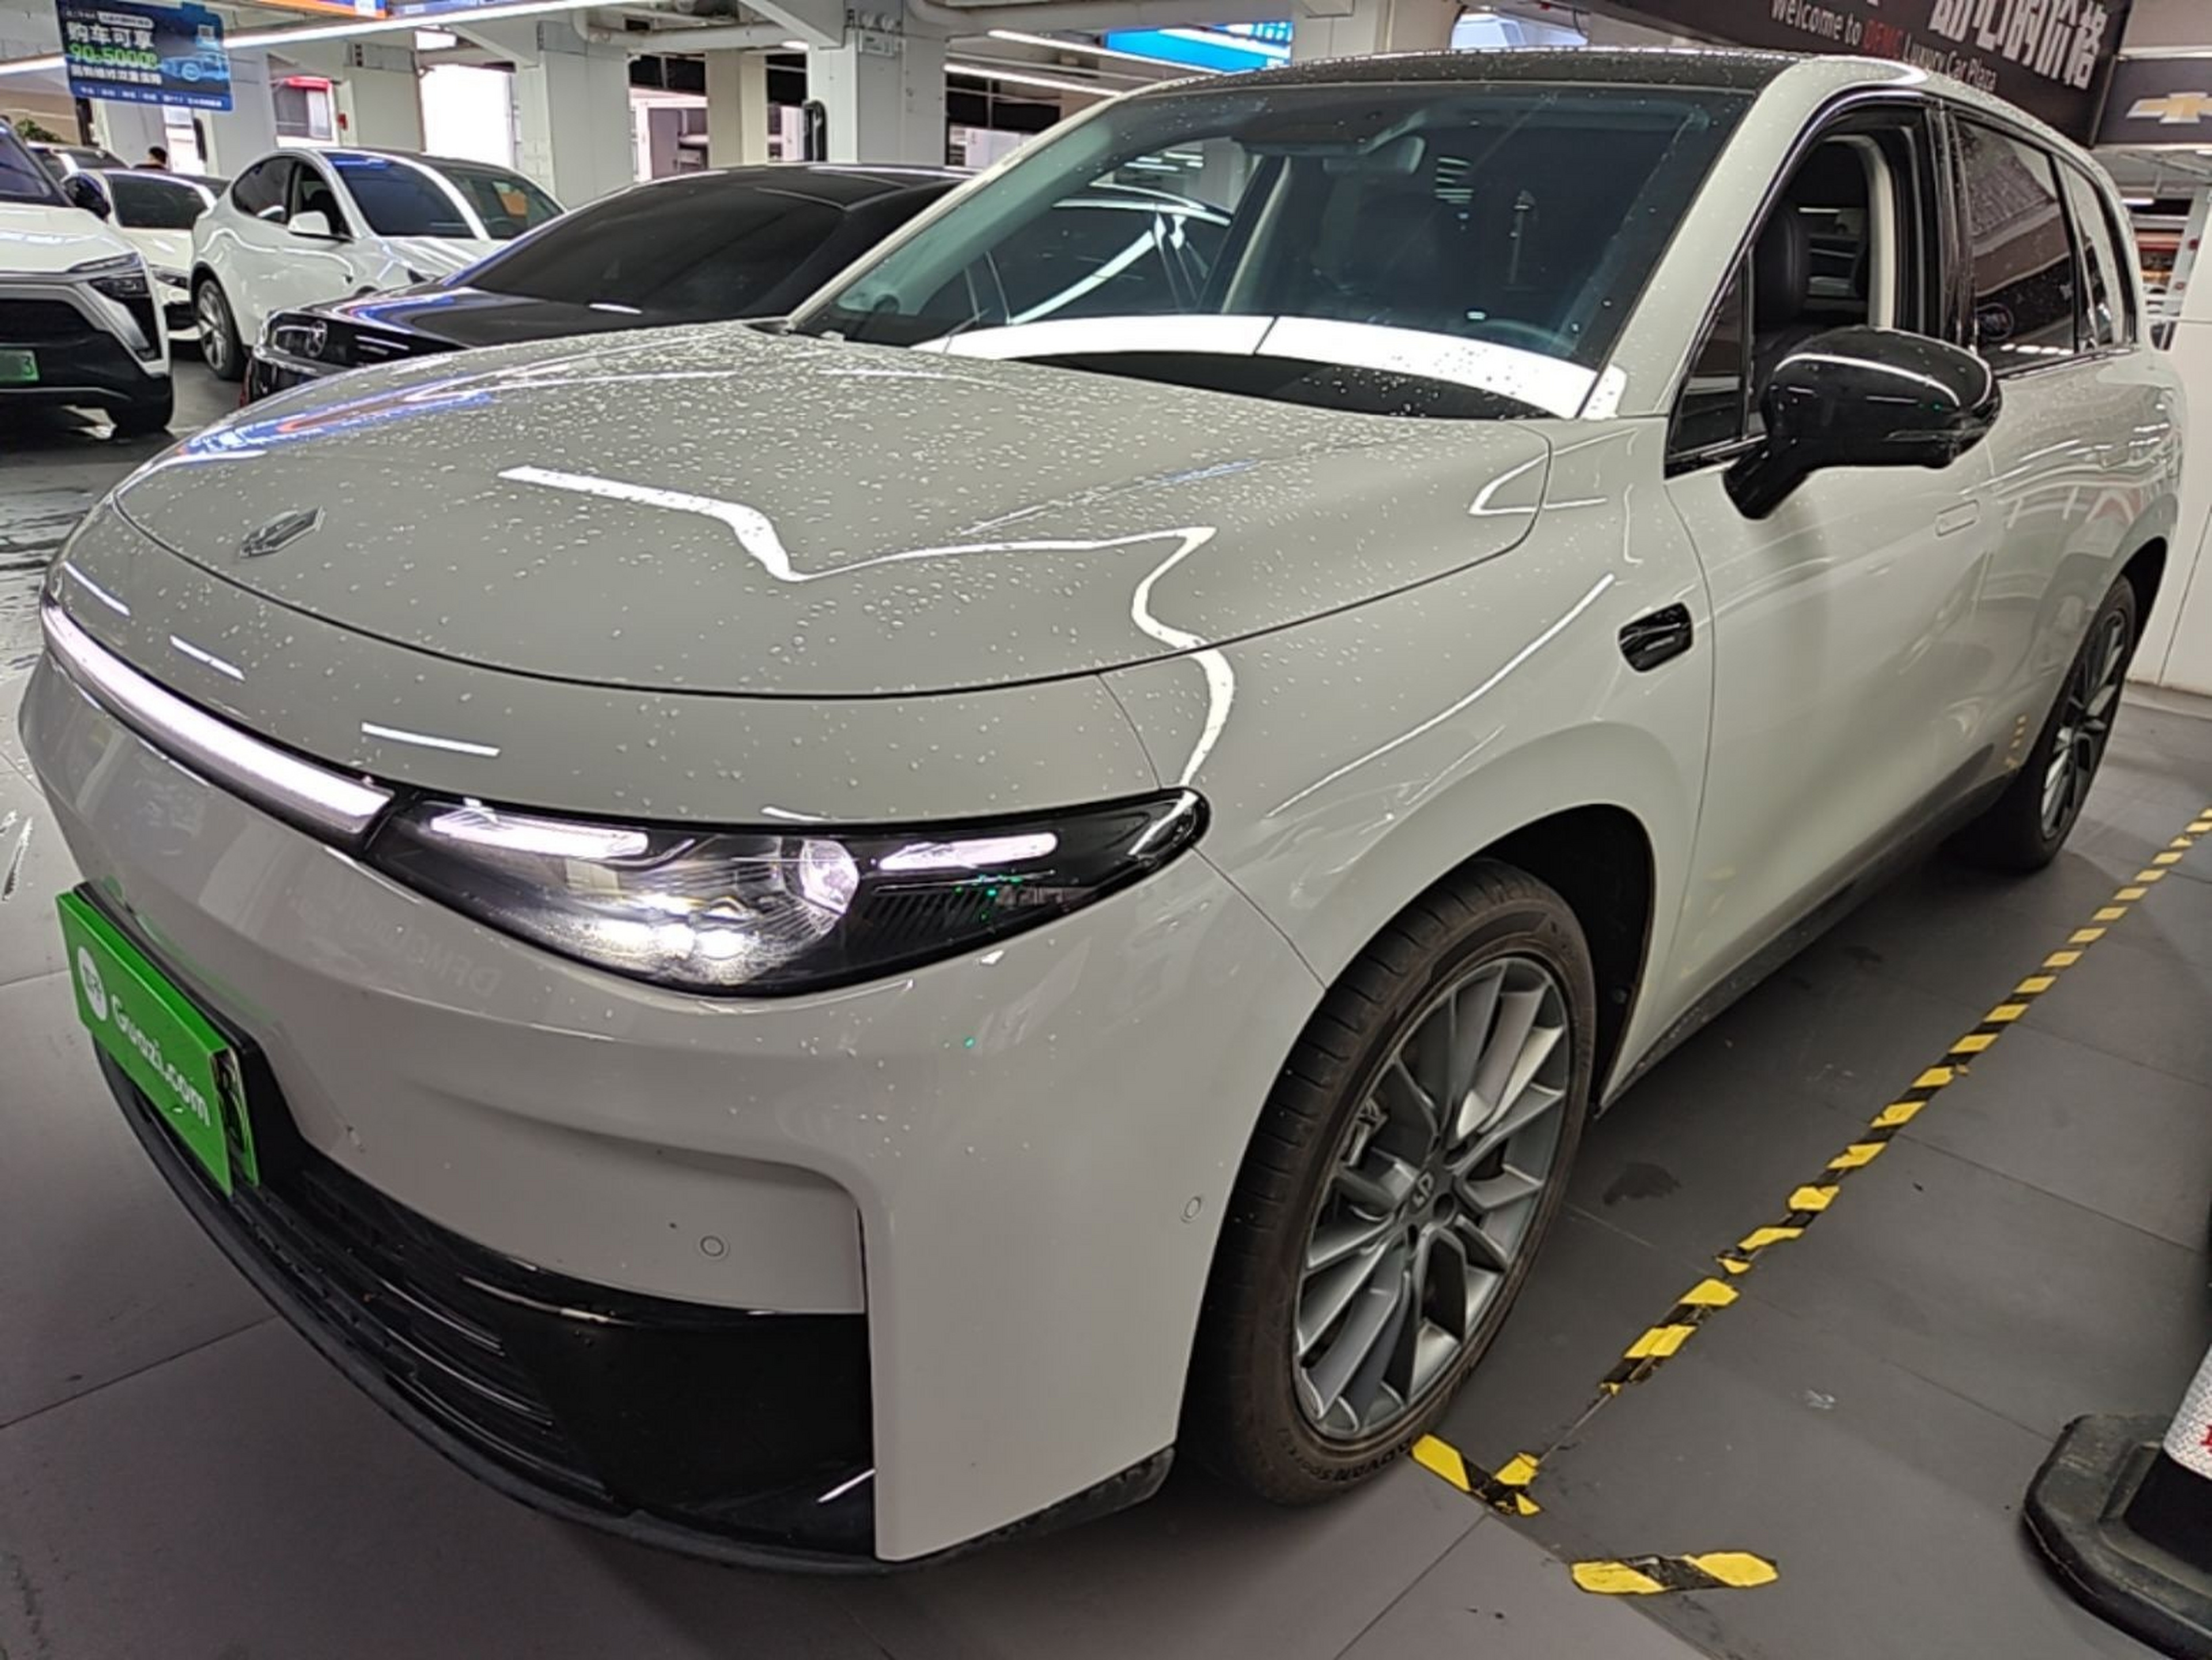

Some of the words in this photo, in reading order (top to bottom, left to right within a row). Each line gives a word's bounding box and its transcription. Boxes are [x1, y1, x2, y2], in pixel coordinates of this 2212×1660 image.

[66, 21, 155, 50] 购车可享
[1771, 0, 1843, 40] Welcome
[1844, 13, 1863, 46] to
[1945, 50, 1968, 81] Car
[1965, 58, 1998, 92] Plaza
[111, 994, 210, 1127] Guazi.com
